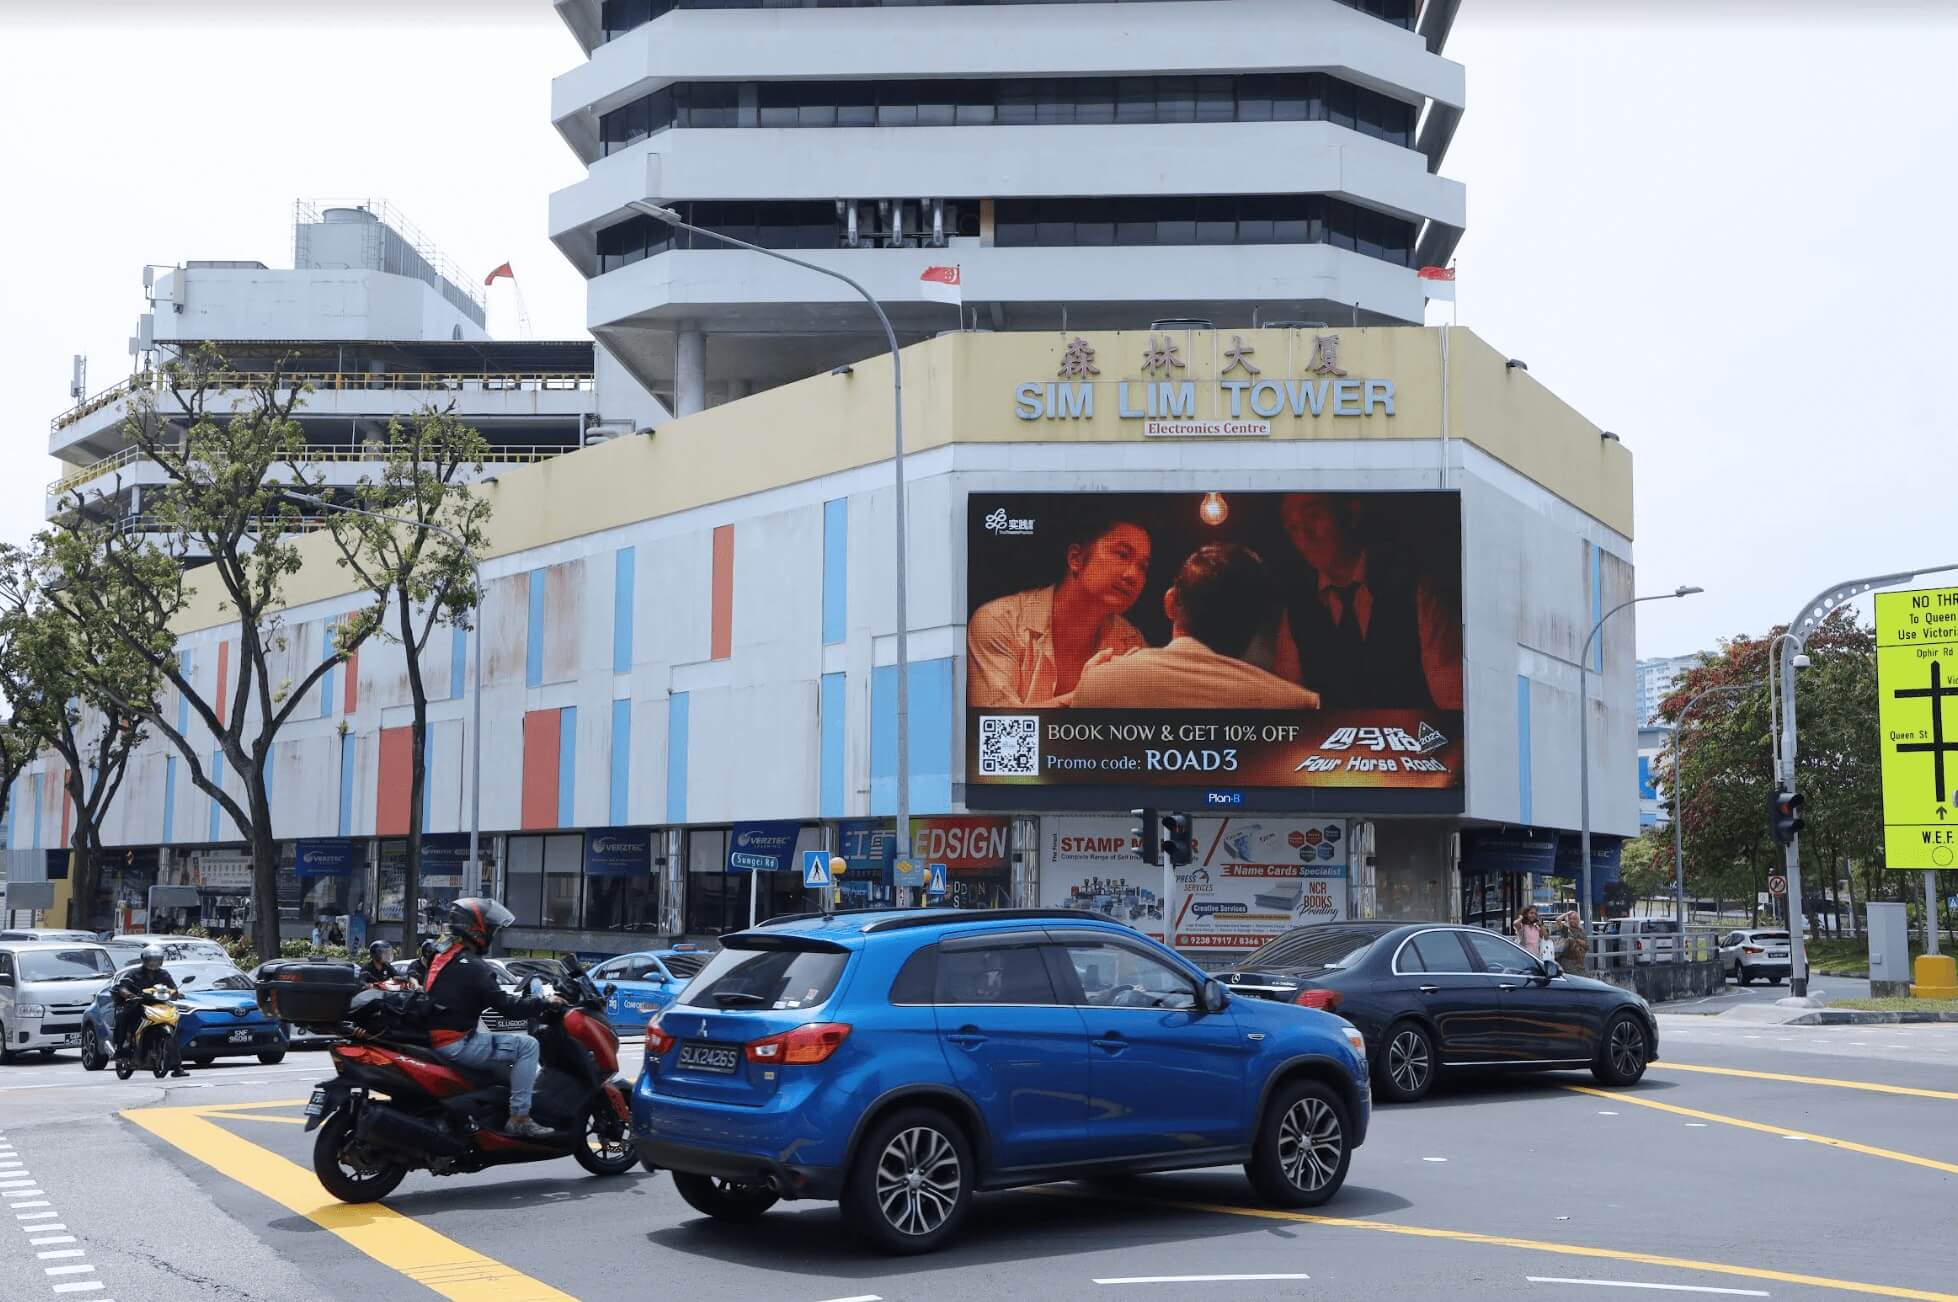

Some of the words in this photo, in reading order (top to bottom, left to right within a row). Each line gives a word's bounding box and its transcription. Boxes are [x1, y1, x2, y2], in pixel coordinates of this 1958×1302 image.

[1057, 335, 1347, 377] 森林大厦
[1015, 383, 1093, 420] SIM
[1119, 382, 1195, 418] LIM
[1221, 379, 1396, 418] TOWER
[1148, 423, 1220, 435] Electronics
[1223, 422, 1267, 434] Centre
[1913, 595, 1930, 608] NO
[1909, 613, 1919, 624] To
[1926, 612, 1956, 624] Queen
[1898, 629, 1917, 640] Use
[1923, 626, 1958, 638] Victori
[1917, 648, 1938, 660] Ophir
[1943, 647, 1954, 657] Rd
[1048, 725, 1103, 741] BOOK
[1109, 725, 1155, 741] NOW
[1161, 726, 1174, 742] &
[1179, 725, 1219, 741] GET
[1224, 726, 1257, 741] 10%
[1262, 726, 1300, 742] OFF
[1419, 731, 1441, 747] 2023
[1890, 730, 1914, 742] Queen
[1919, 730, 1928, 739] St
[1047, 756, 1097, 769] Promo
[1101, 756, 1142, 770] code:
[1145, 750, 1238, 771] ROAD3
[1295, 756, 1342, 772] Four
[1346, 757, 1397, 772] Horse
[1400, 757, 1447, 772] Road
[1922, 831, 1954, 844] W.E.F.
[1061, 837, 1125, 852] STAMP
[737, 855, 763, 867] Sungei
[765, 858, 775, 868] Rd
[1234, 866, 1264, 875] Name
[1267, 866, 1297, 875] Cards
[1299, 867, 1341, 876] Specialist
[1309, 882, 1327, 894] NCR
[1193, 904, 1219, 912] Creative
[1220, 904, 1247, 913] Services
[1303, 896, 1333, 909] BOOKS
[1297, 904, 1338, 921] Printing
[1212, 937, 1232, 945] 7917
[680, 1046, 737, 1068] SLK2426S
